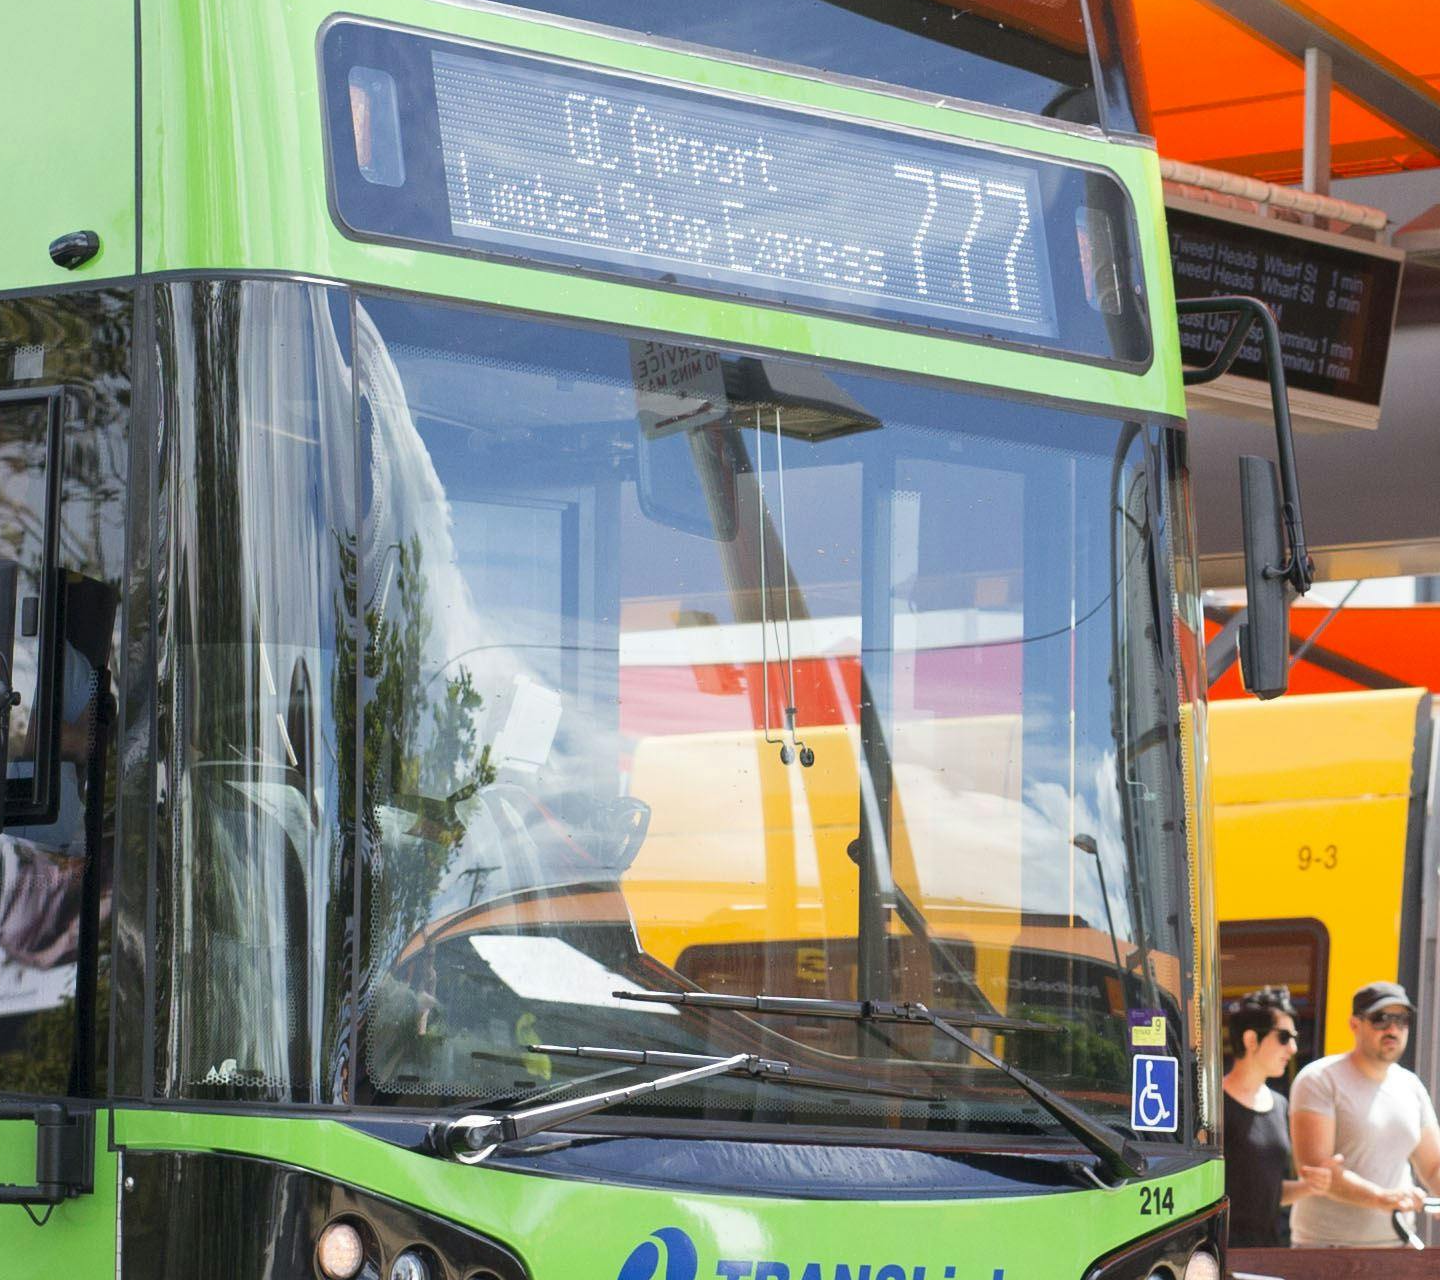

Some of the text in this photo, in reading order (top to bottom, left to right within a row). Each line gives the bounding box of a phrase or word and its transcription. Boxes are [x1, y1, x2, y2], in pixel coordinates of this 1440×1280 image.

[630, 104, 778, 193] Airport
[459, 151, 888, 289] Limited Stop Express
[893, 163, 1031, 311] 777
[1173, 233, 1214, 261] Tweed
[1216, 247, 1258, 270] Heads
[1264, 255, 1303, 277] Wharf
[1306, 265, 1318, 283] St
[1341, 274, 1364, 294] min
[1213, 268, 1255, 290] Heads
[1261, 276, 1300, 297] Wharf
[1300, 285, 1315, 304] St
[1326, 291, 1336, 308] 8
[1337, 295, 1360, 314] min
[1327, 362, 1350, 380] min
[1330, 341, 1353, 360] min
[1297, 844, 1339, 871] 9-3
[1139, 1186, 1175, 1216] 214
